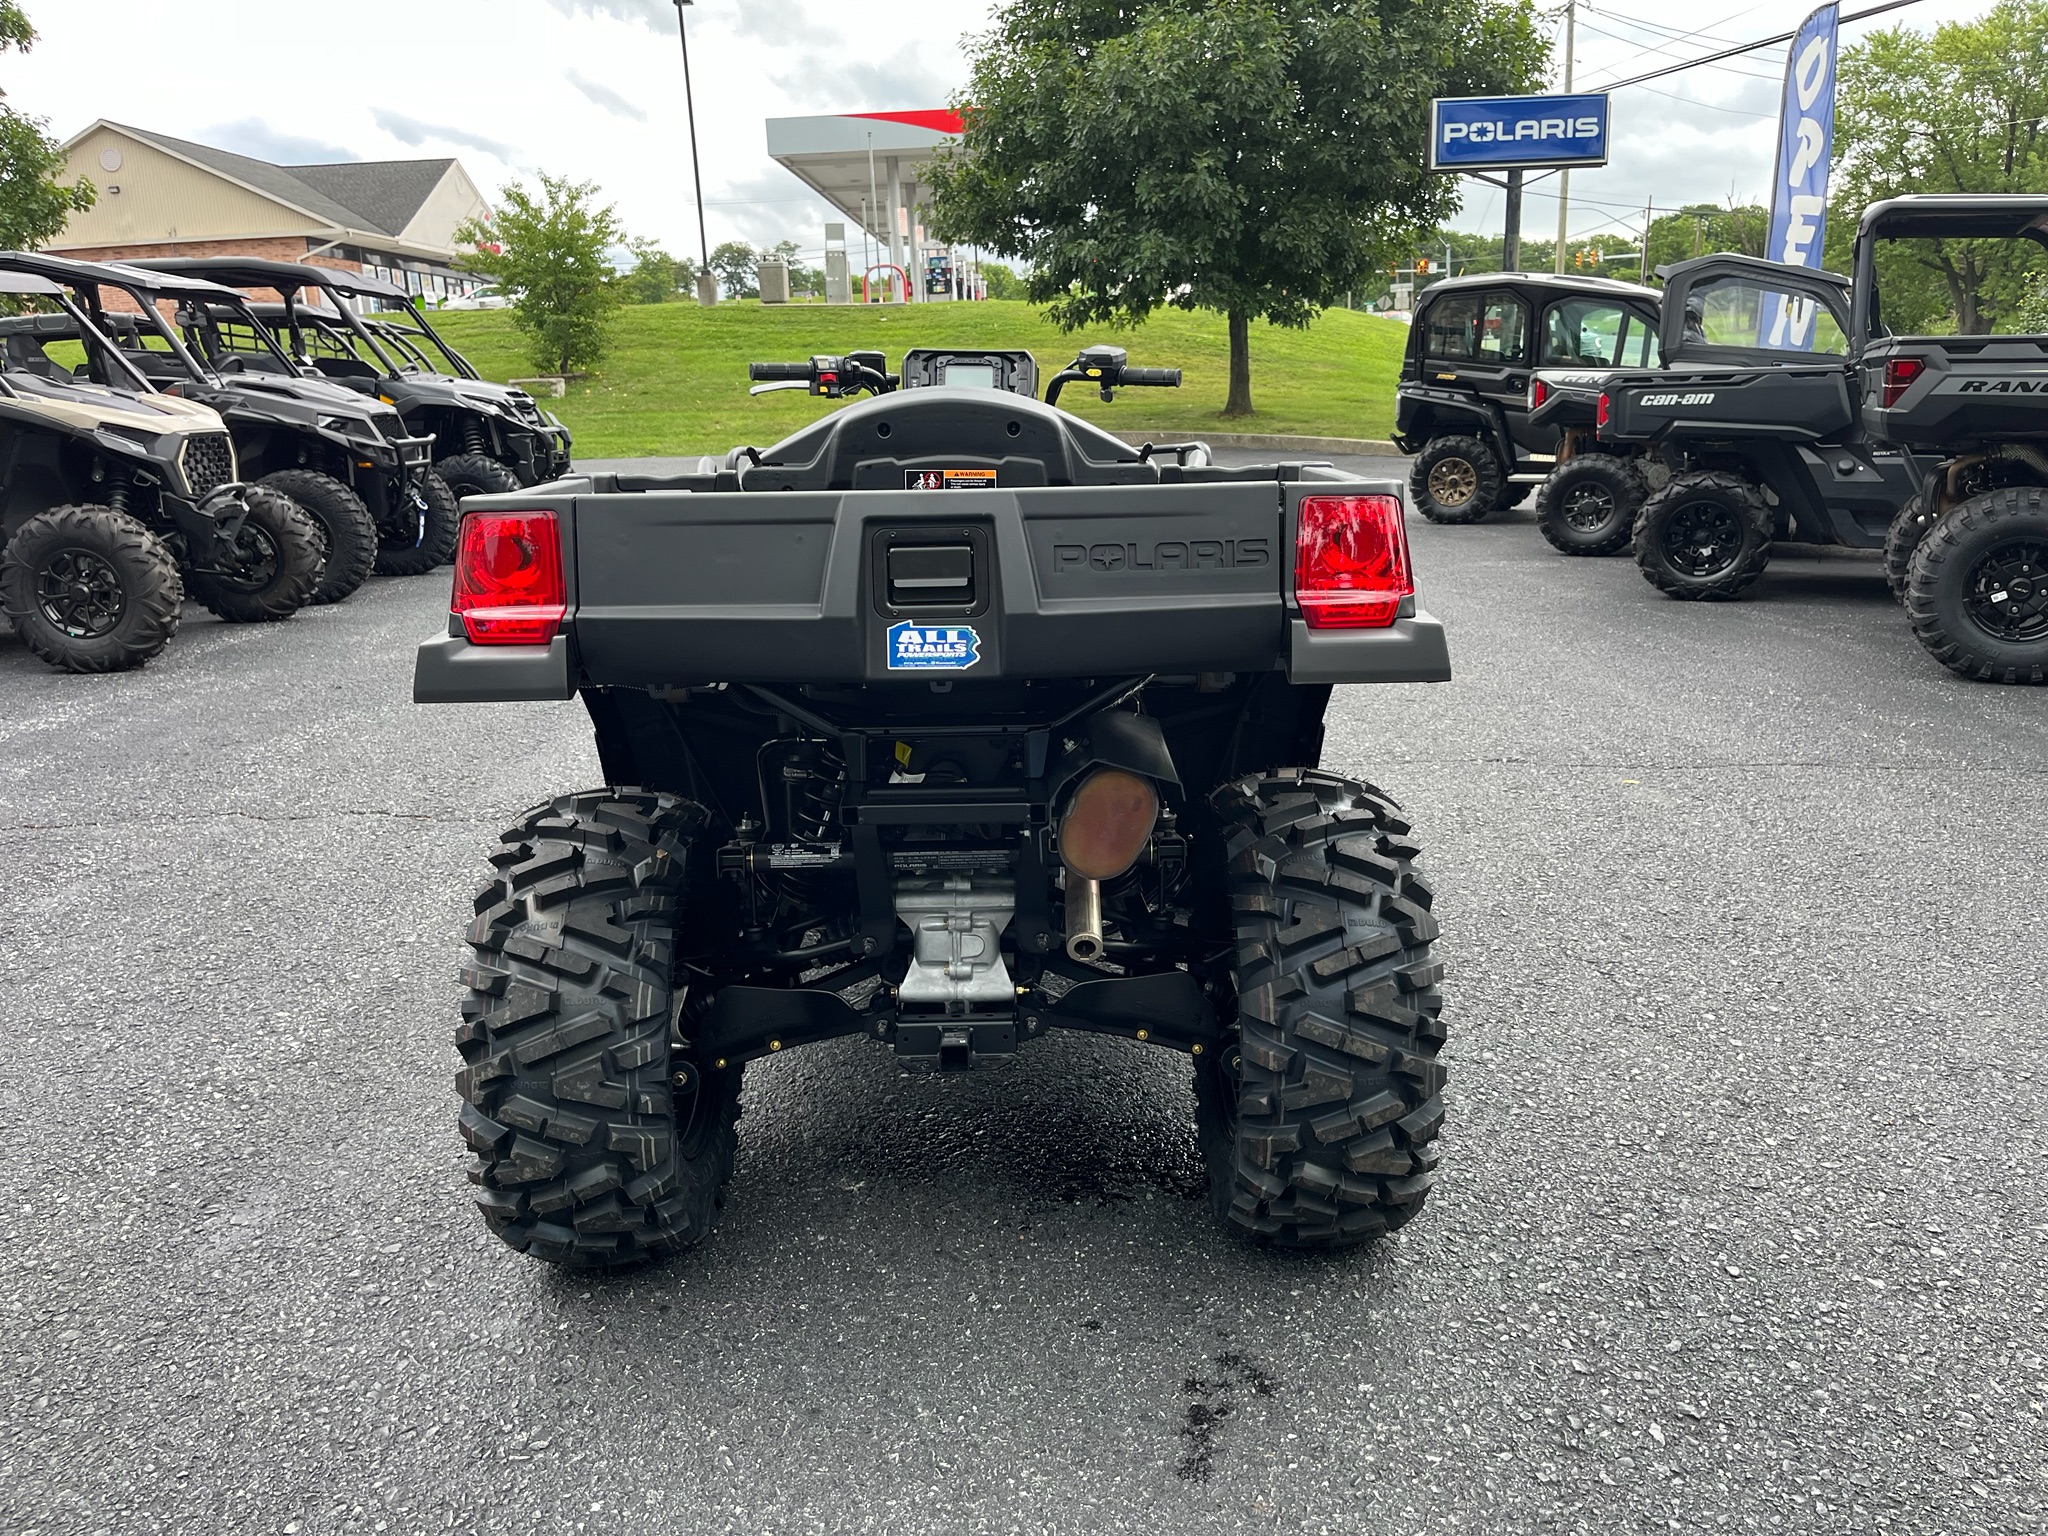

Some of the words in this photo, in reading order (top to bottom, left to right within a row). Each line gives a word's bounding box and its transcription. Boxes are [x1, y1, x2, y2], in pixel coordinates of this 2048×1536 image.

[1443, 117, 1600, 143] POLARIS
[1768, 35, 1830, 347] OPEN
[1562, 375, 1603, 384] GEN
[1640, 393, 1715, 406] can-am
[1053, 538, 1270, 573] POLARIS
[897, 630, 967, 644] ALL
[896, 643, 967, 653] TRAILS
